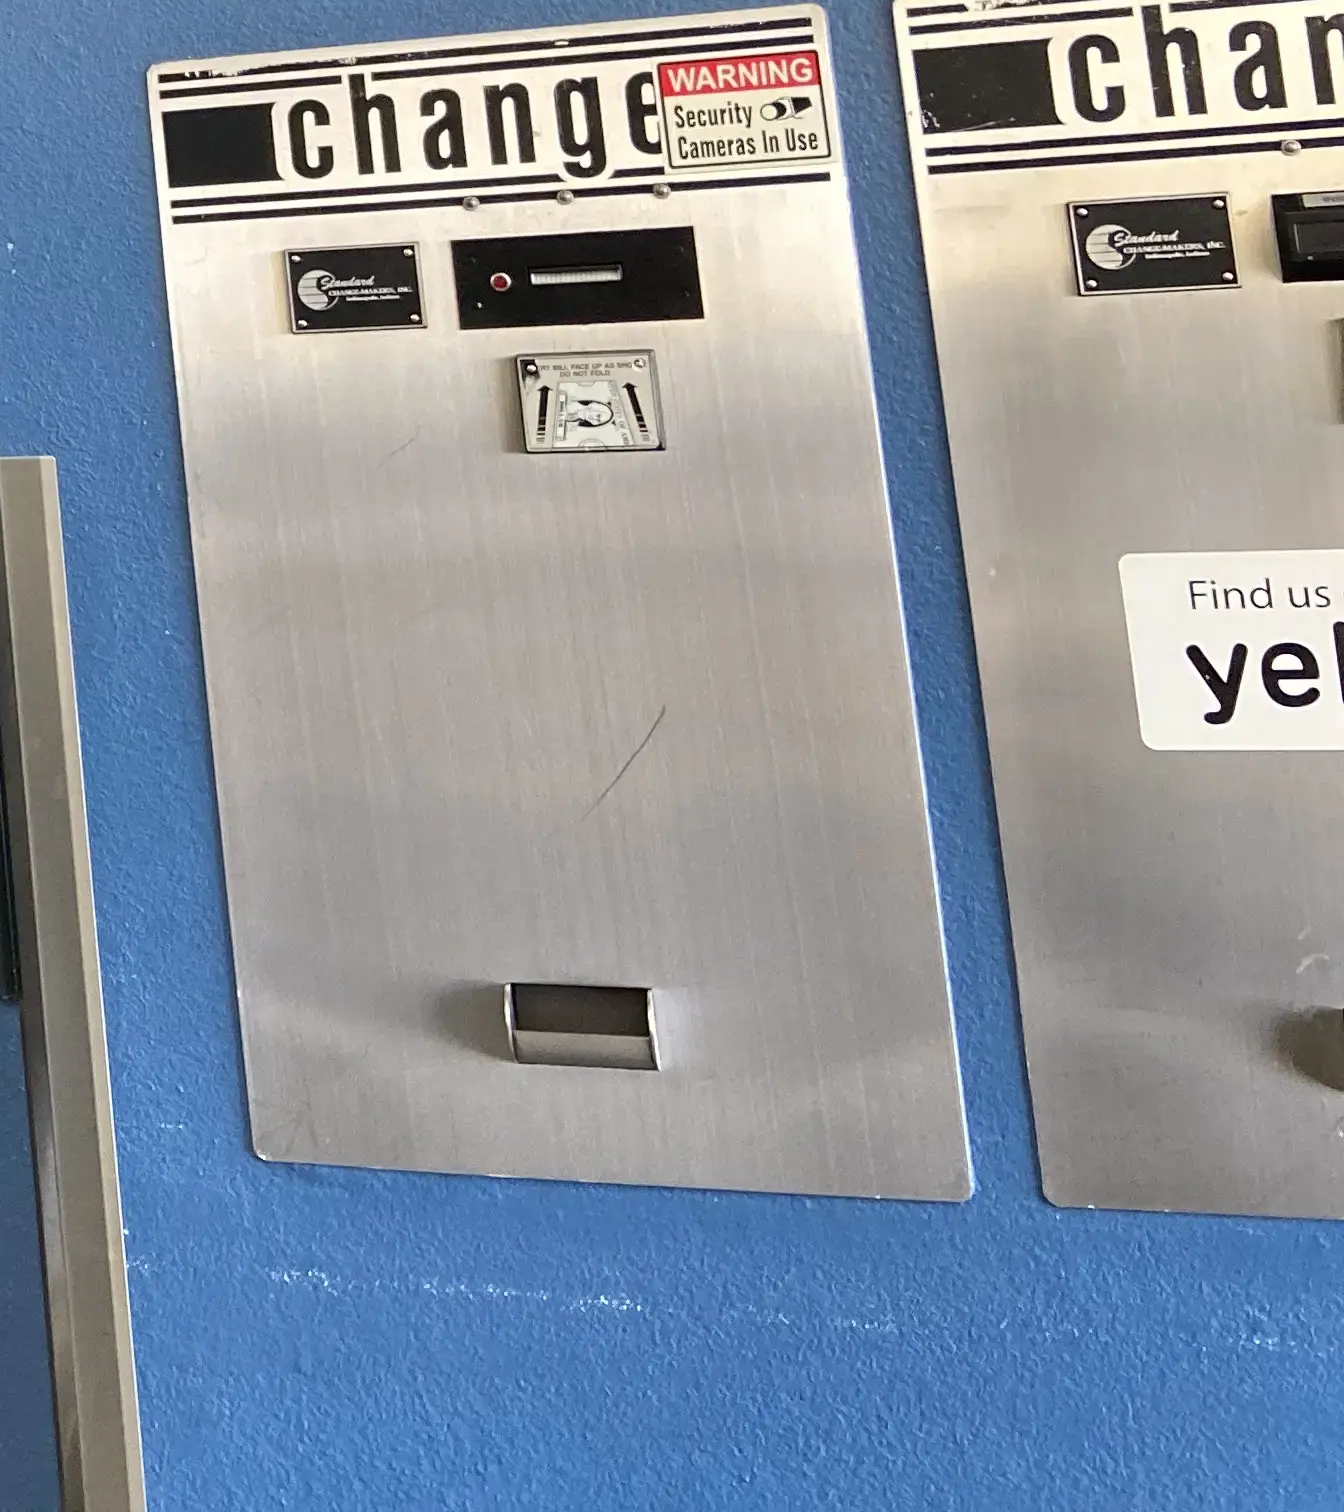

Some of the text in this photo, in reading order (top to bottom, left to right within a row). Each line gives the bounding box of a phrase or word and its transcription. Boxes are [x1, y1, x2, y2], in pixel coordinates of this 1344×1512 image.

[667, 57, 813, 93] WARNING
[287, 71, 662, 180] change
[674, 100, 752, 129] Security
[677, 127, 819, 160] Cameras In Use
[1188, 577, 1331, 610] Find us
